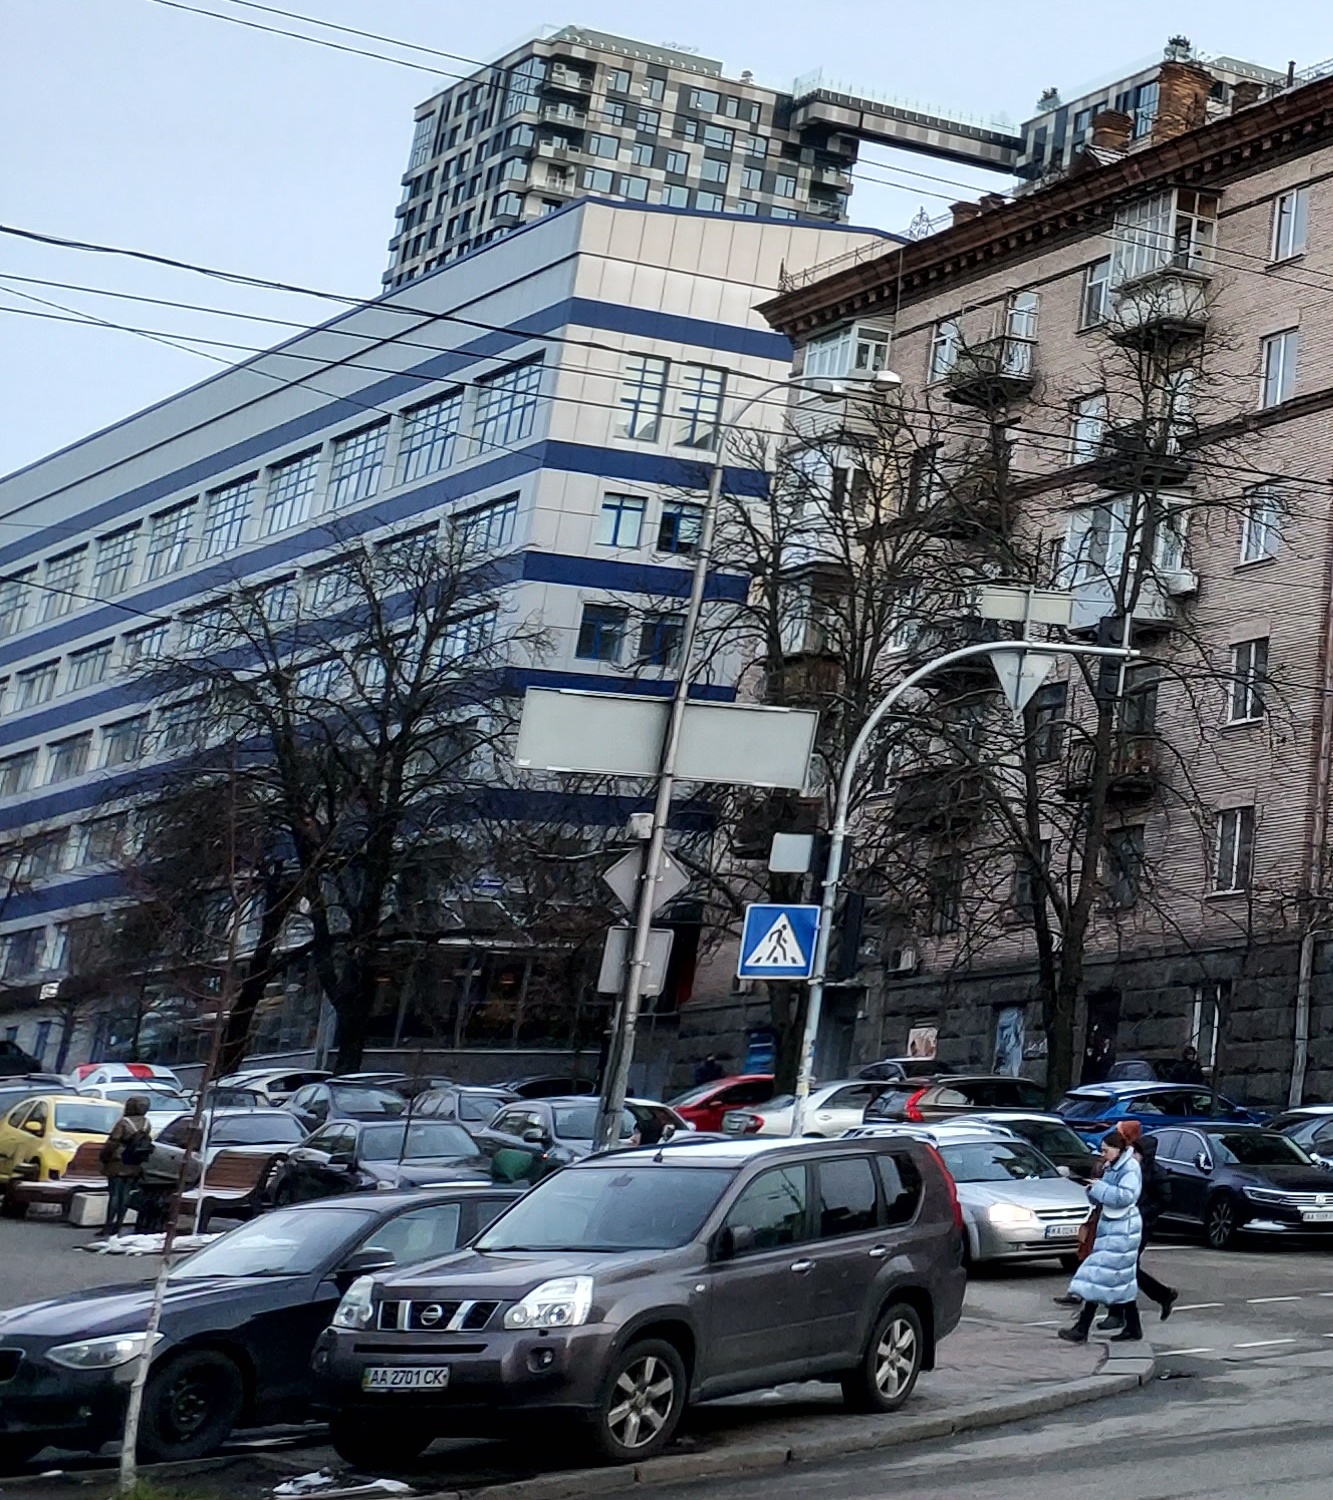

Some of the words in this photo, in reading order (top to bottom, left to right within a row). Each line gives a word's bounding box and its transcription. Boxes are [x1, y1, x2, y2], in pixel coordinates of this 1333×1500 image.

[370, 1370, 388, 1385] AA
[391, 1370, 420, 1385] 2701
[423, 1370, 444, 1385] CK
